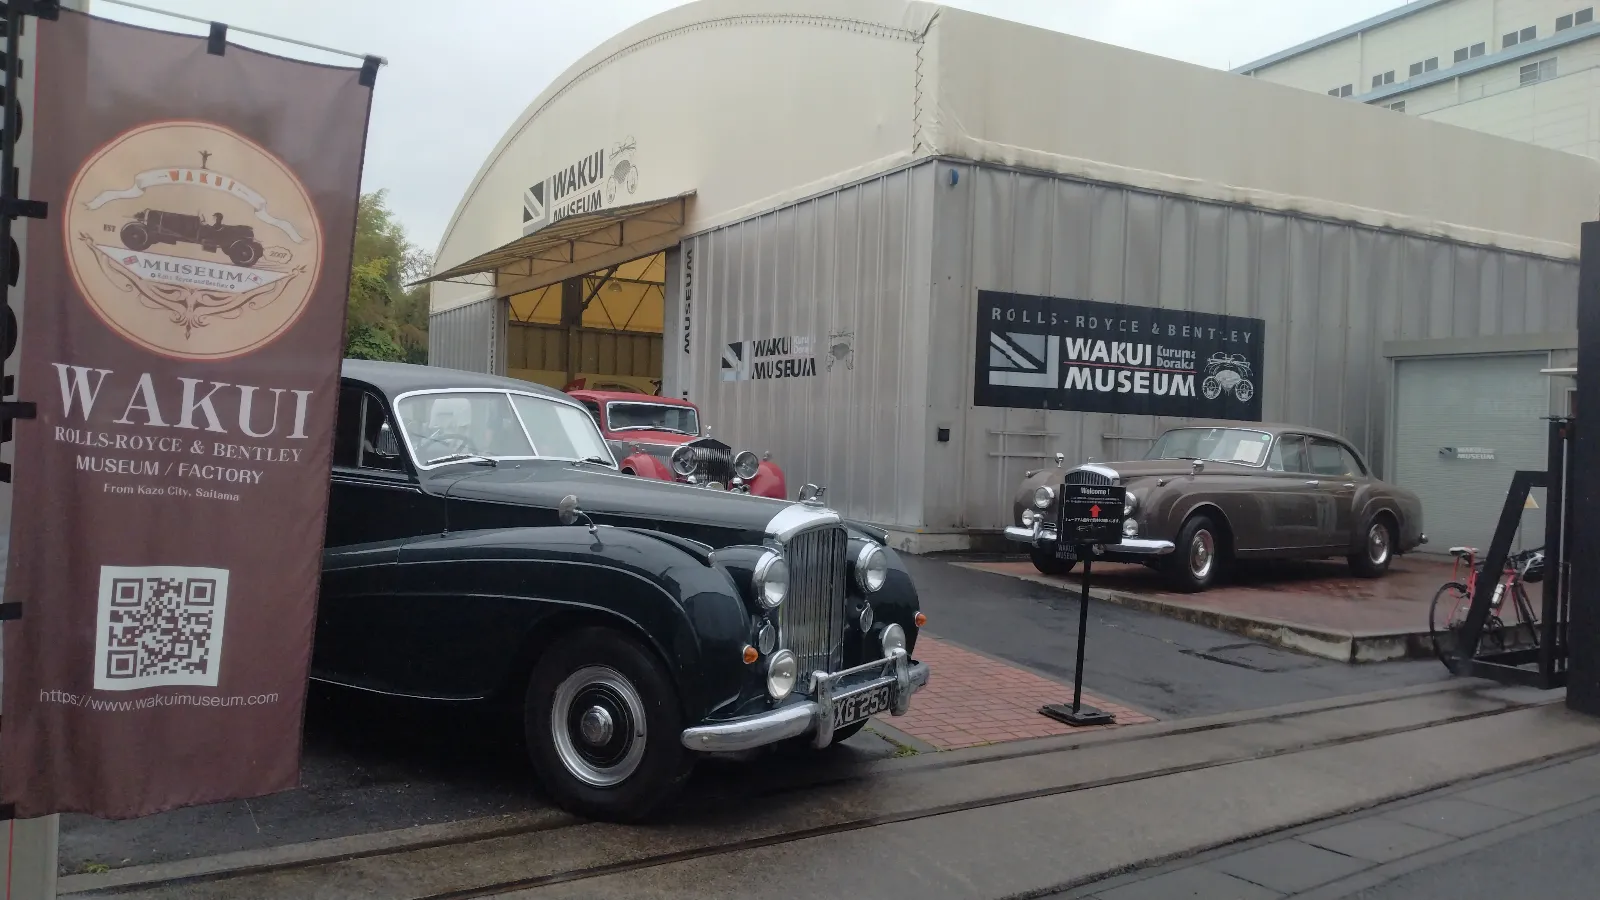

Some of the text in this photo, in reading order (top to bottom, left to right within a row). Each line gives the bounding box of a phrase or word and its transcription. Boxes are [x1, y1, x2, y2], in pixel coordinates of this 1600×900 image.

[168, 169, 235, 191] WAKUI
[553, 149, 604, 200] WAKUI
[103, 223, 116, 233] EST
[269, 250, 287, 259] 2007
[143, 258, 243, 283] MUSEUM
[683, 249, 693, 354] MUSEUM
[991, 307, 1139, 333] ROLLS-ROYCE
[1152, 322, 1160, 335] &
[753, 336, 791, 358] WAKUI
[1064, 337, 1152, 366] WAKUI
[1156, 345, 1196, 359] Kuruma
[752, 357, 817, 380] MUSEUM
[1064, 366, 1196, 397] MUSEUM
[51, 362, 314, 440] WAKUI
[54, 426, 303, 463] ROLLS-ROYCE & BENTLEY
[76, 454, 264, 485] MUSEUM / FACTORY
[103, 483, 240, 502] From Kazo City, Saitama
[39, 689, 279, 712] https://www.wakuimuseum.com
